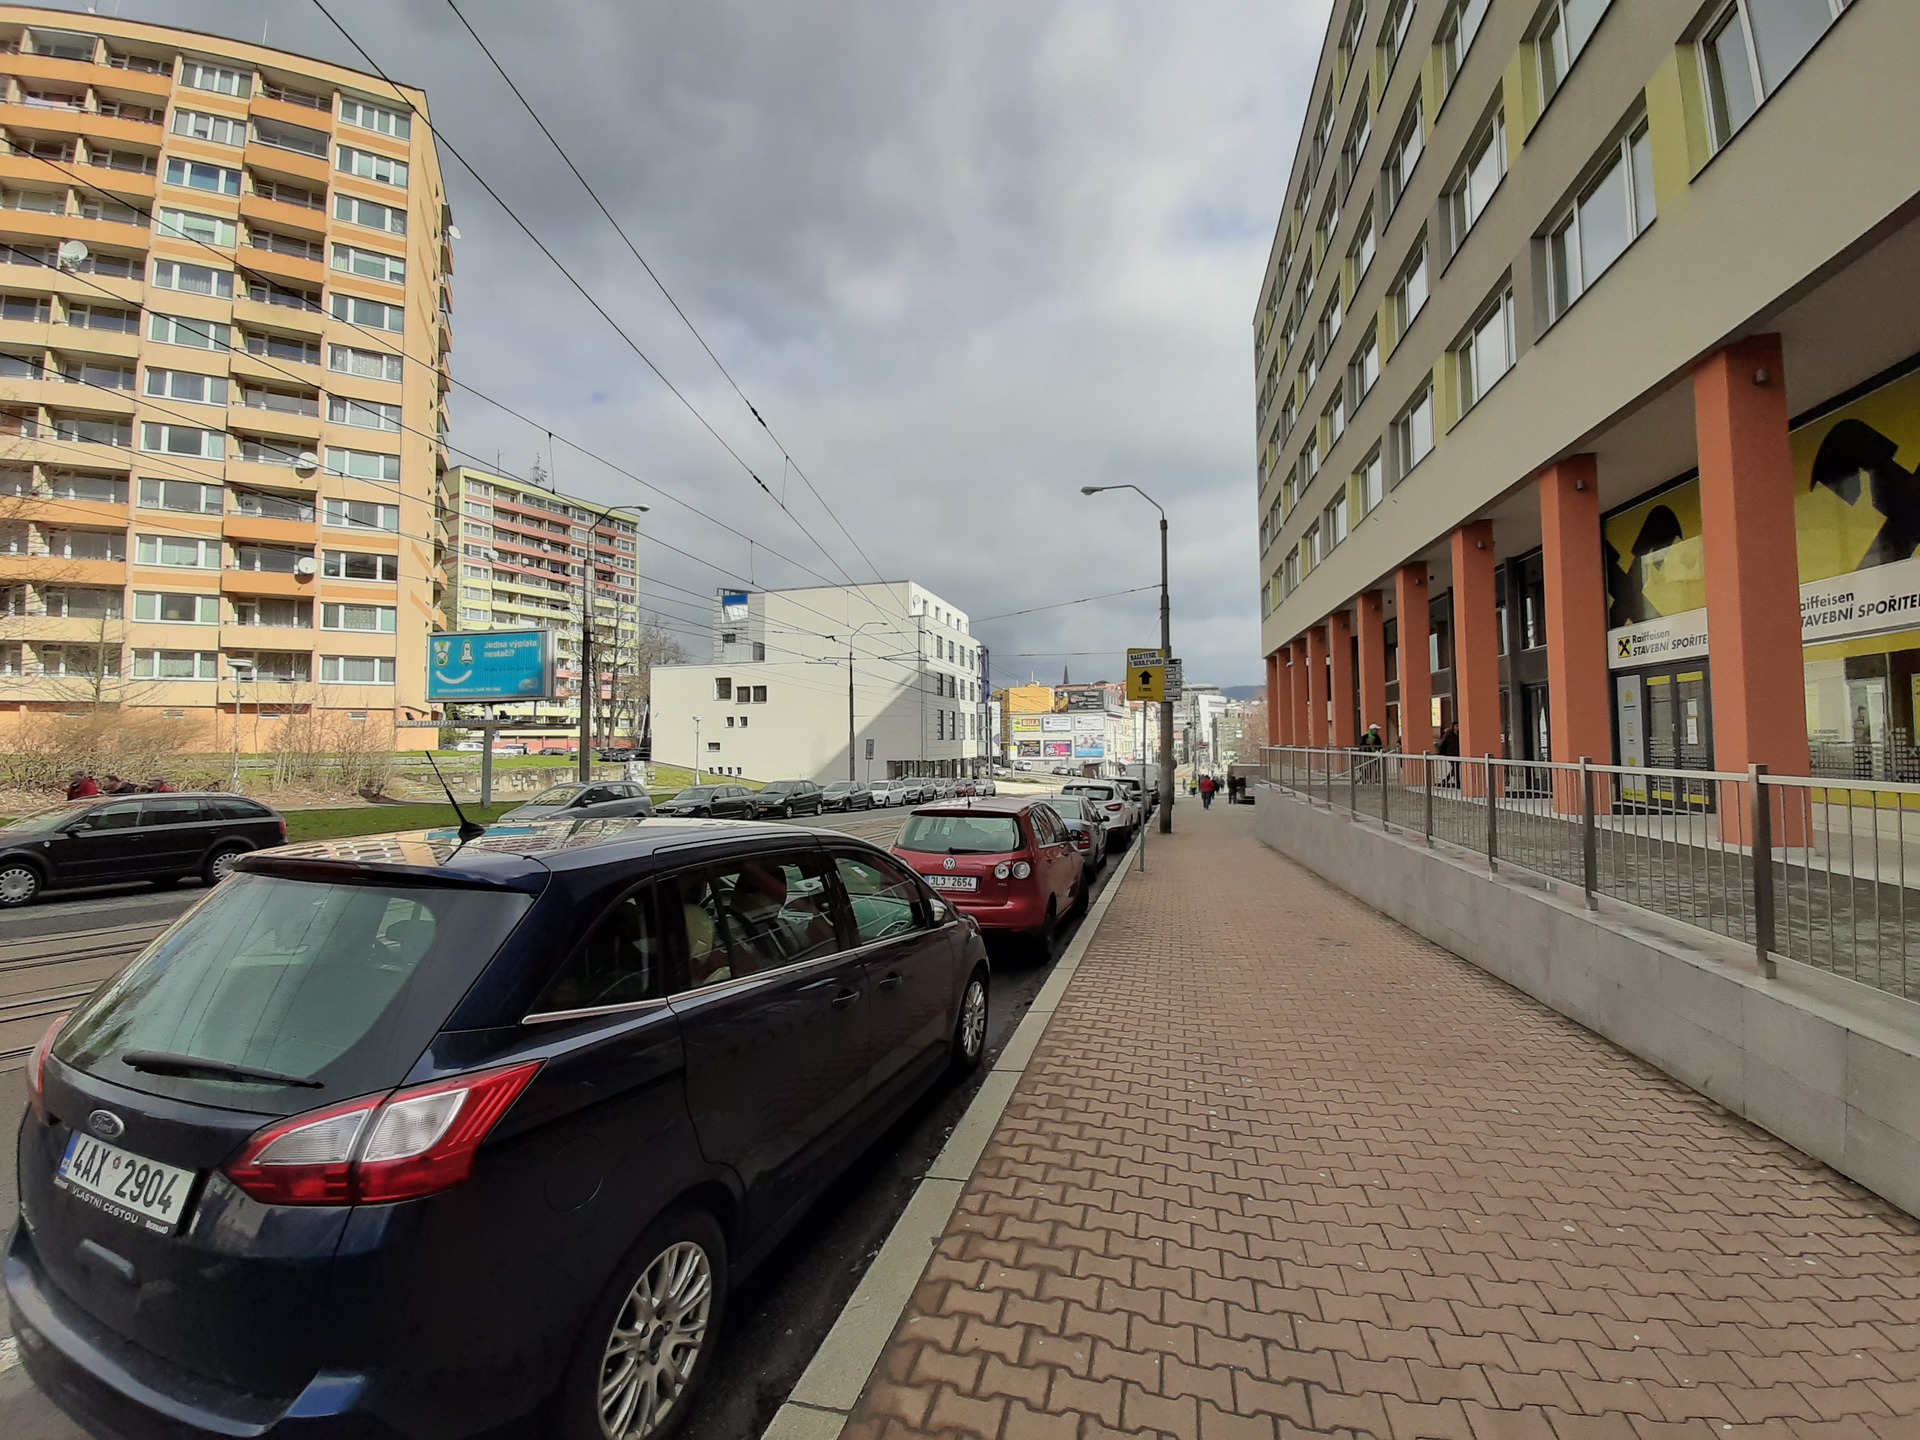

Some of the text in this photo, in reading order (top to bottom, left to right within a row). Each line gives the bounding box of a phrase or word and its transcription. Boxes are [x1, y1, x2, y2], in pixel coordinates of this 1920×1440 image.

[1800, 592, 1854, 612] aiffeisen
[1801, 603, 1854, 628] AVEBNÍ
[484, 640, 537, 650] Jedna výplata
[1632, 630, 1670, 644] Raiffeisen
[1633, 639, 1670, 656] STAVEBNÍ
[930, 876, 973, 887] 3L3 2654
[73, 1140, 180, 1215] 4AX 2904
[103, 1202, 139, 1224] CESTOU
